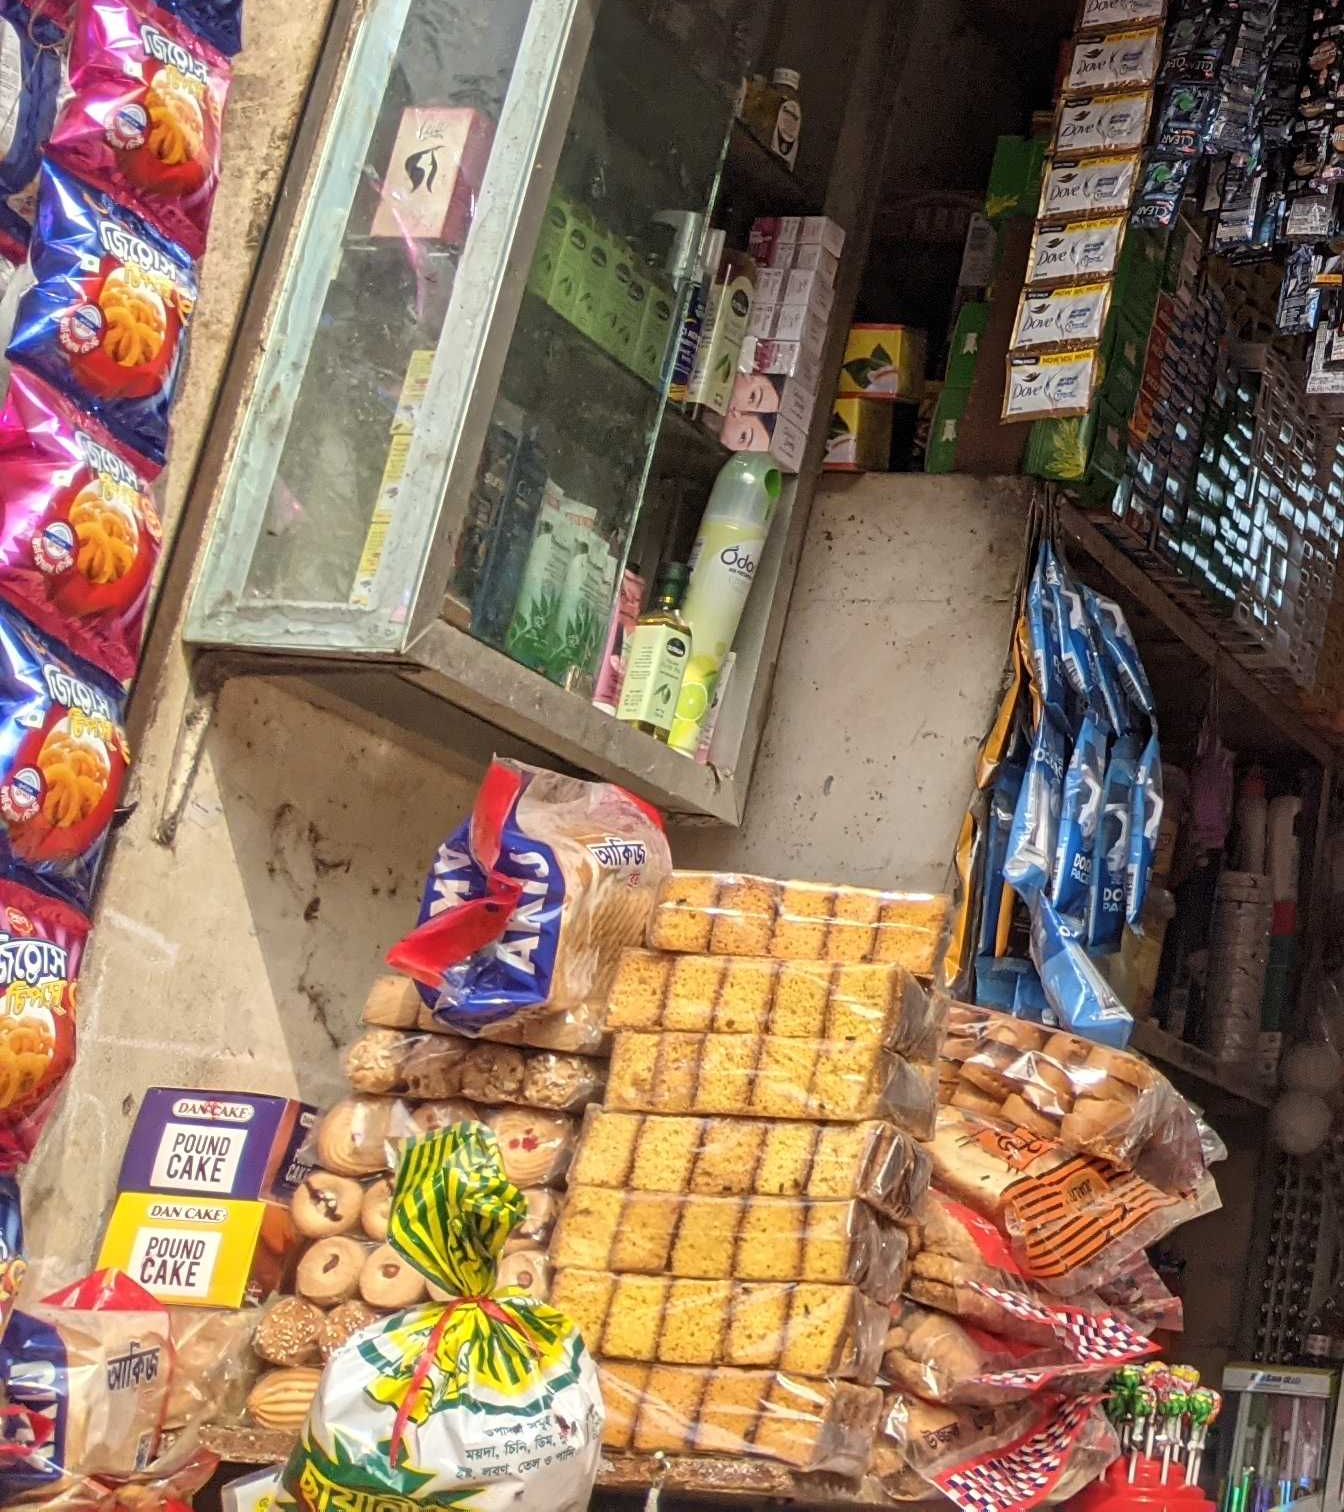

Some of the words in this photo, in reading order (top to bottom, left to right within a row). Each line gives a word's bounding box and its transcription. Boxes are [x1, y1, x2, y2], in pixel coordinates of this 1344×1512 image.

[1050, 184, 1080, 201] Dove
[1136, 205, 1171, 219] CLEAR
[1037, 250, 1067, 266] Dove
[1022, 316, 1053, 332] Dove
[1013, 383, 1042, 400] Dove
[594, 838, 647, 866] আকিজ
[172, 1132, 231, 1157] POUND
[166, 1153, 226, 1183] CAKE
[150, 1205, 183, 1218] DAN
[185, 1207, 223, 1221] CAKE
[145, 1236, 206, 1260] POUND
[139, 1256, 201, 1287] CAKE
[107, 1341, 161, 1391] আকিজ
[464, 1447, 500, 1462] ময়দা,
[503, 1438, 531, 1457] চিনি,
[517, 1457, 541, 1474] তেল
[555, 1447, 576, 1464] পানি
